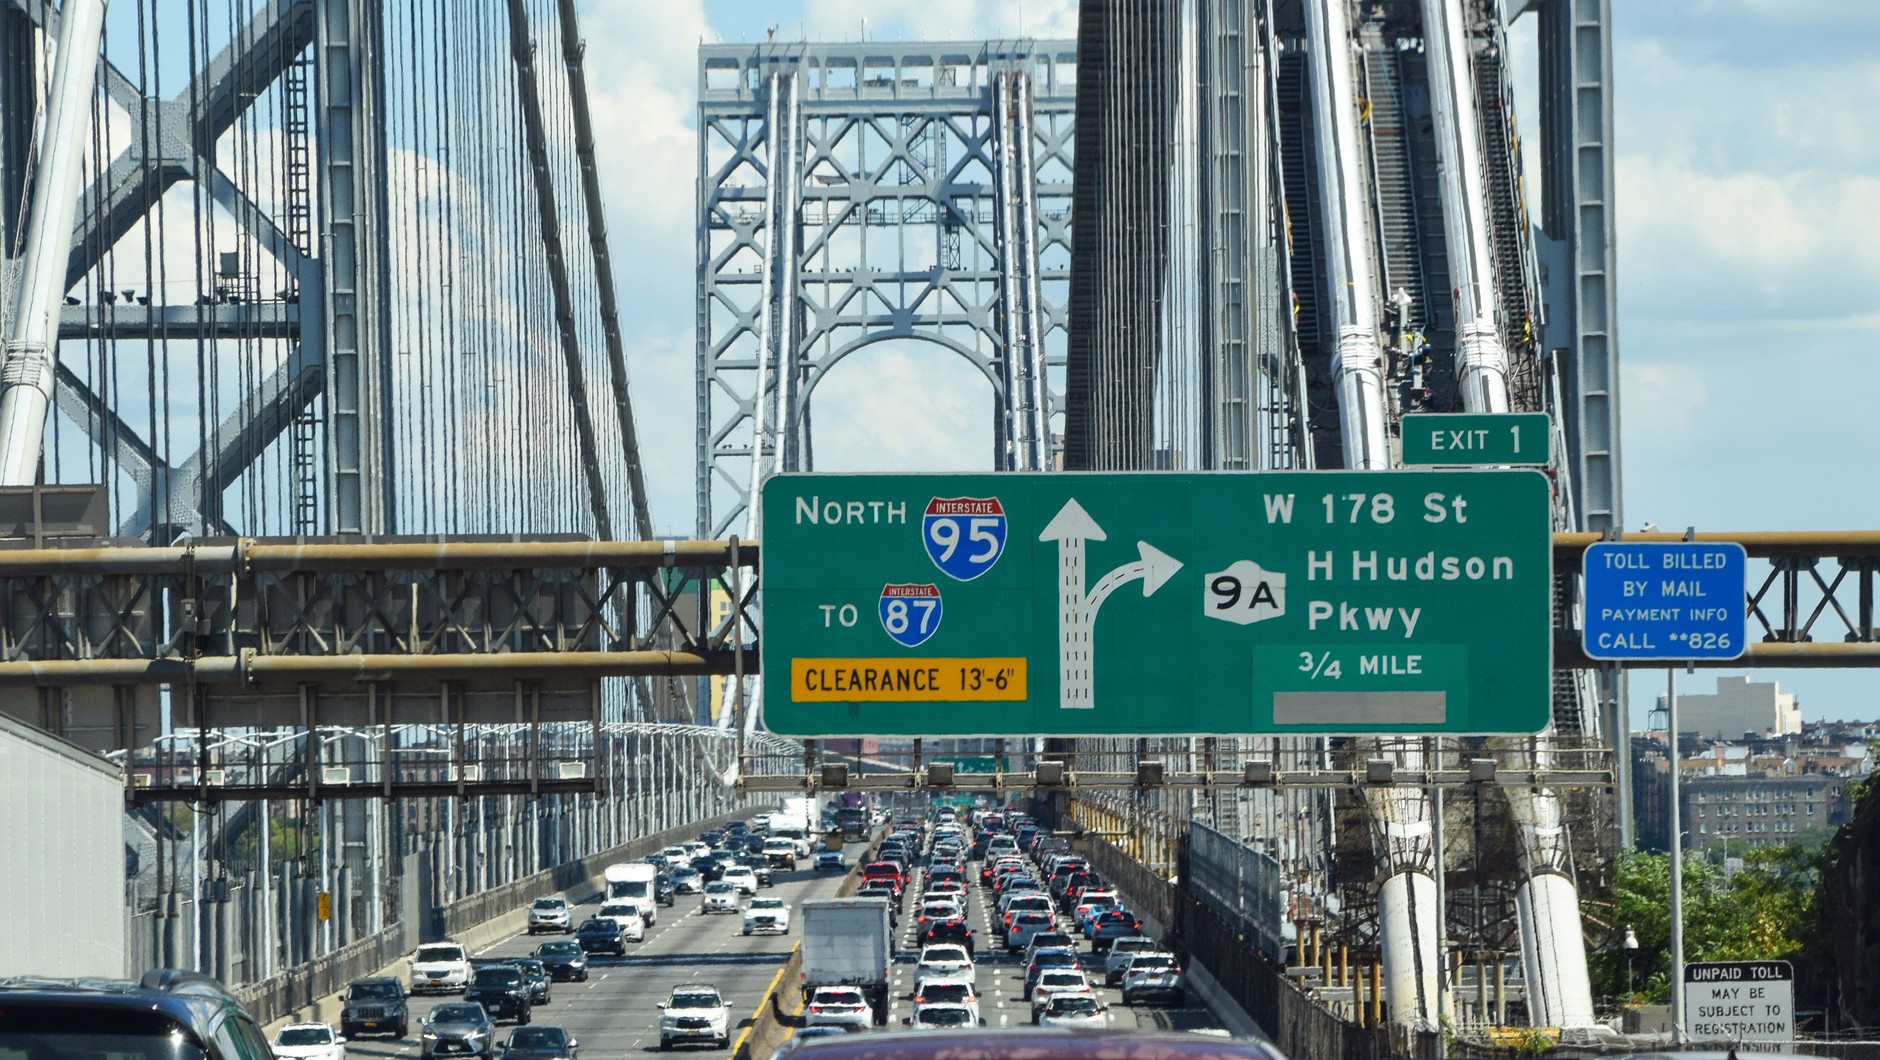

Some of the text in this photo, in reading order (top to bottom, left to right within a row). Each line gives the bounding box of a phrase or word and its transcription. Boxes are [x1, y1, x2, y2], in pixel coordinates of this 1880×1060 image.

[1431, 425, 1522, 453] EXIT 1
[795, 496, 906, 524] NORTH
[936, 502, 993, 514] INTERSTATE
[1263, 493, 1467, 524] W 178 St
[930, 518, 999, 564] 95
[1307, 550, 1513, 580] H Hudson
[1604, 553, 1727, 570] TOLL BILLED
[888, 587, 933, 597] INTERSTATE
[1211, 575, 1279, 611] 9A
[1623, 581, 1707, 597] BY MAIL
[818, 604, 859, 628] TO
[885, 599, 937, 634] 87
[1308, 600, 1422, 639] Pkwy
[1602, 608, 1728, 621] PAYMENT INFO
[1598, 632, 1656, 649] CALL
[1359, 655, 1423, 675] MILE
[805, 668, 940, 692] CLEARANCE
[1693, 967, 1783, 981] UNPAID TOLL
[1711, 987, 1765, 1000] MAY BE
[1698, 1005, 1781, 1017] SUBJECT TO
